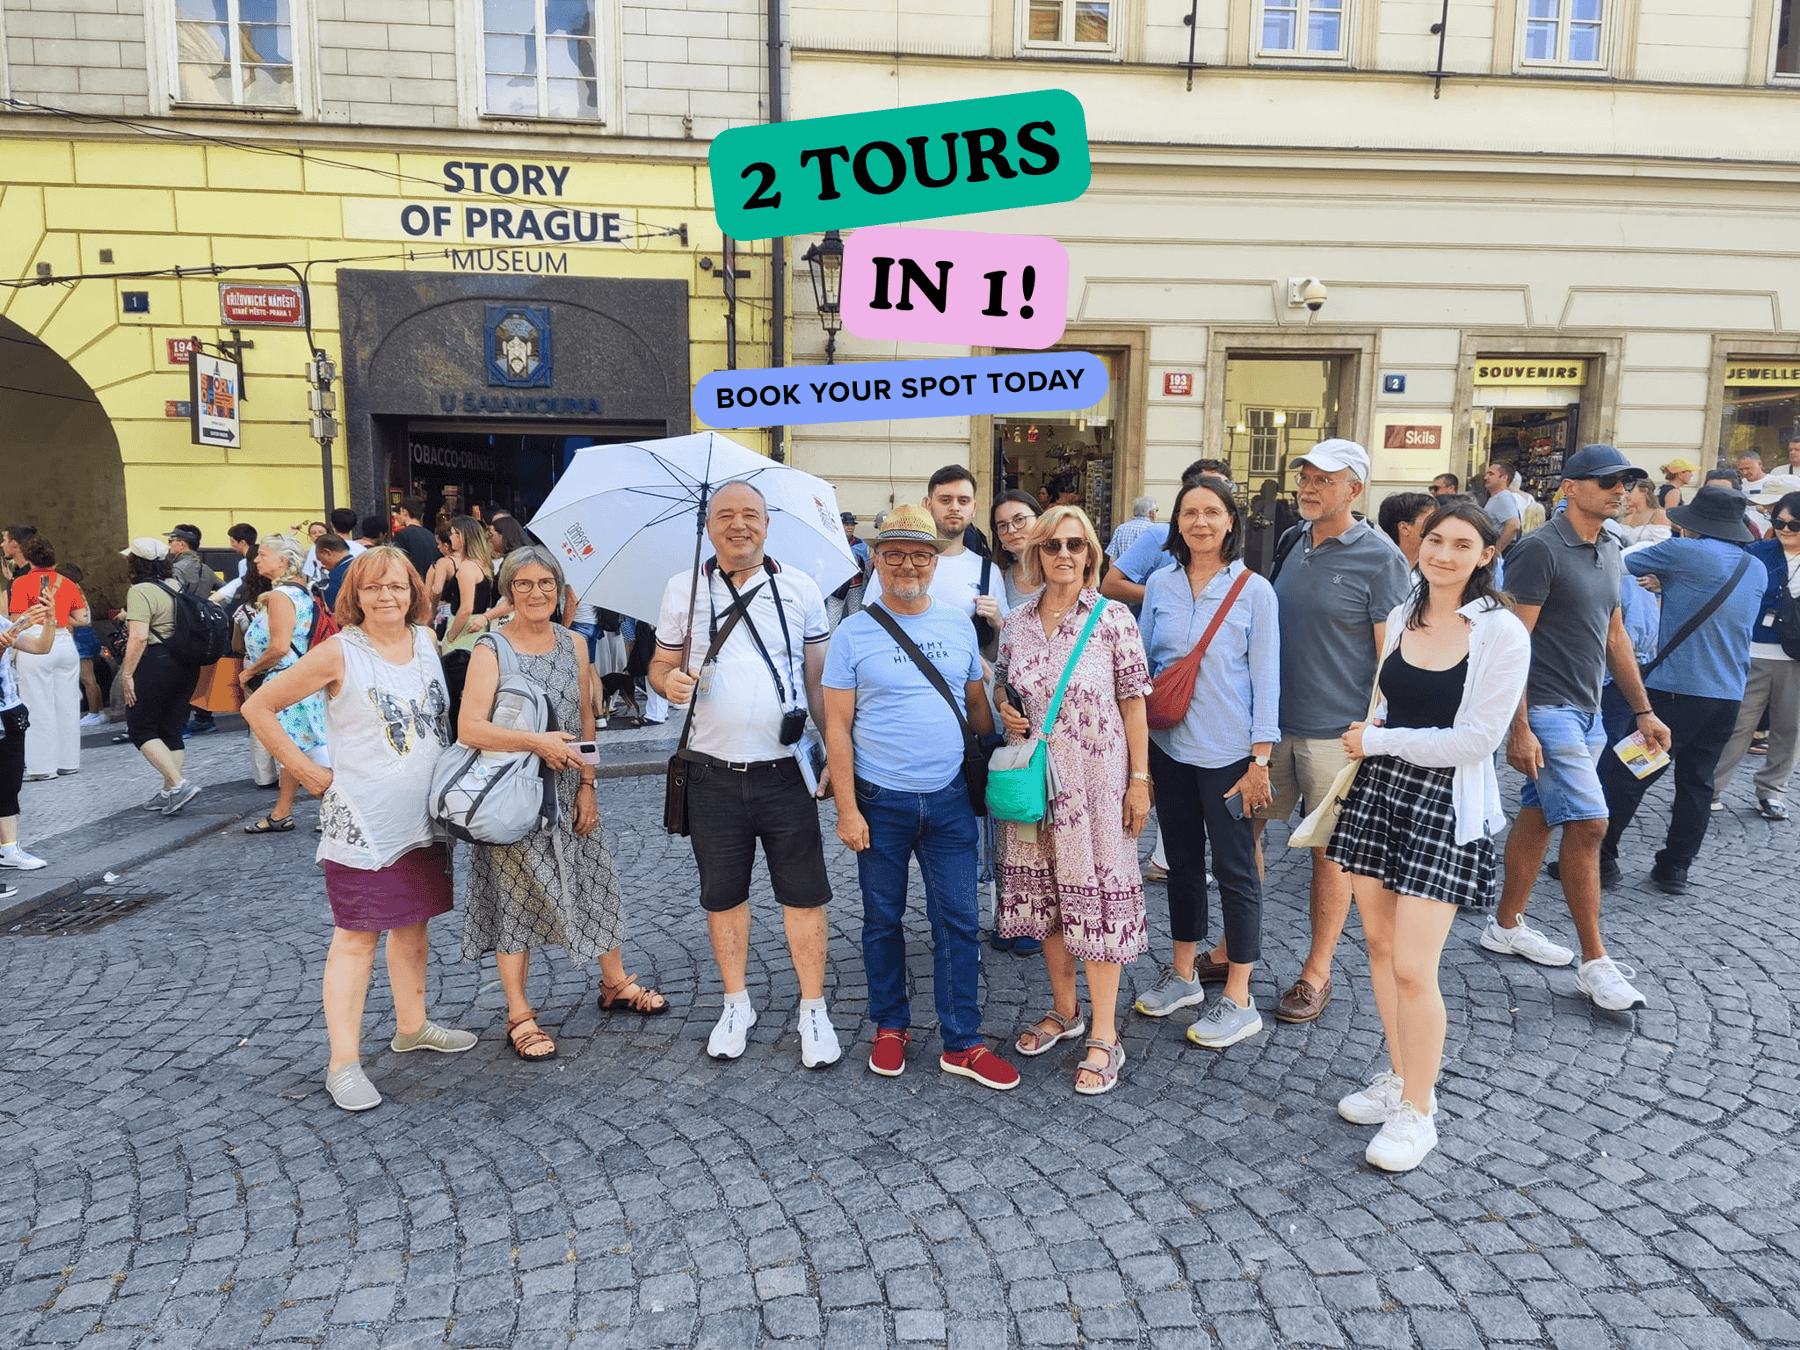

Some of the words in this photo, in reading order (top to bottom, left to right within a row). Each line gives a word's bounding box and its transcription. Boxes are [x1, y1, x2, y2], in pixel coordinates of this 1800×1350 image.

[443, 161, 570, 197] STORY
[400, 204, 451, 238] OF
[465, 207, 621, 243] PRAGUE
[451, 248, 568, 274] MUSEUM
[131, 295, 138, 308] 1
[173, 341, 193, 353] 194
[1478, 366, 1578, 379] SOUVENIRS
[1170, 374, 1187, 386] 193
[1392, 378, 1399, 390] 2
[439, 393, 457, 412] U
[1405, 430, 1436, 445] Skils
[895, 641, 943, 654] TMMY
